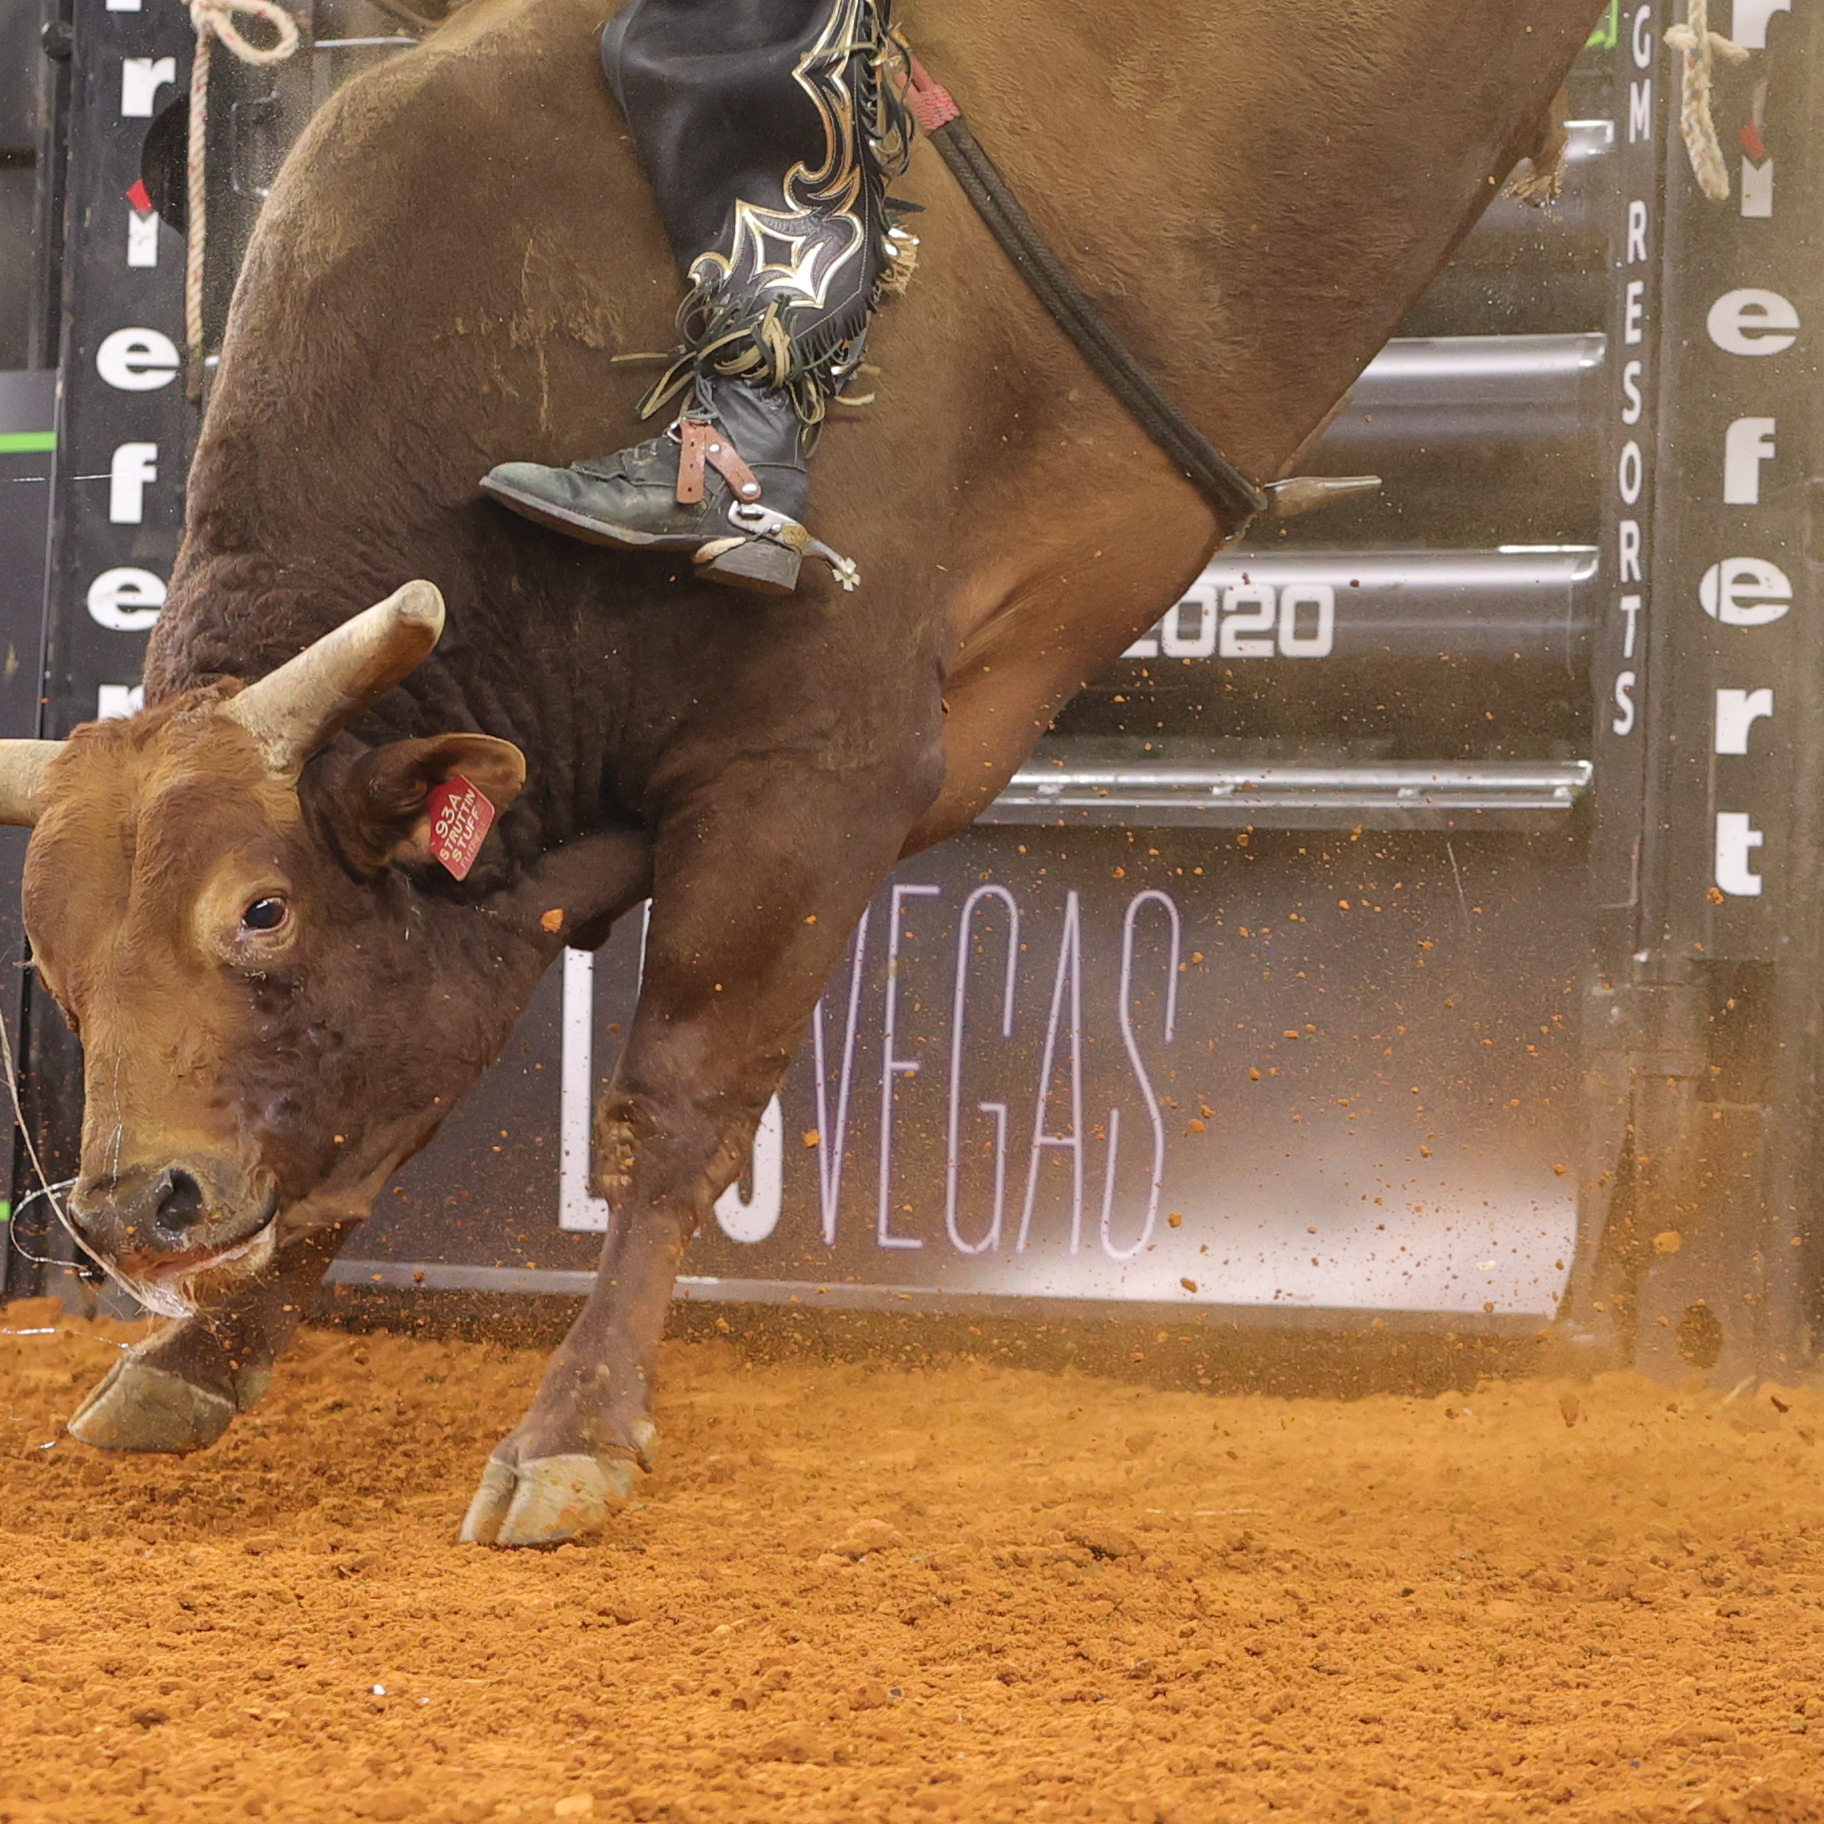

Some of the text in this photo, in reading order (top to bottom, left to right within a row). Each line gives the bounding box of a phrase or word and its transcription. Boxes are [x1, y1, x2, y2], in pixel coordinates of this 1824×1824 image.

[1613, 200, 1648, 736] RESORTS
[435, 793, 462, 839] 93A
[439, 788, 476, 861] STRUTTIN
[451, 805, 479, 863] STUFF
[811, 883, 1182, 1259] VEGAS
